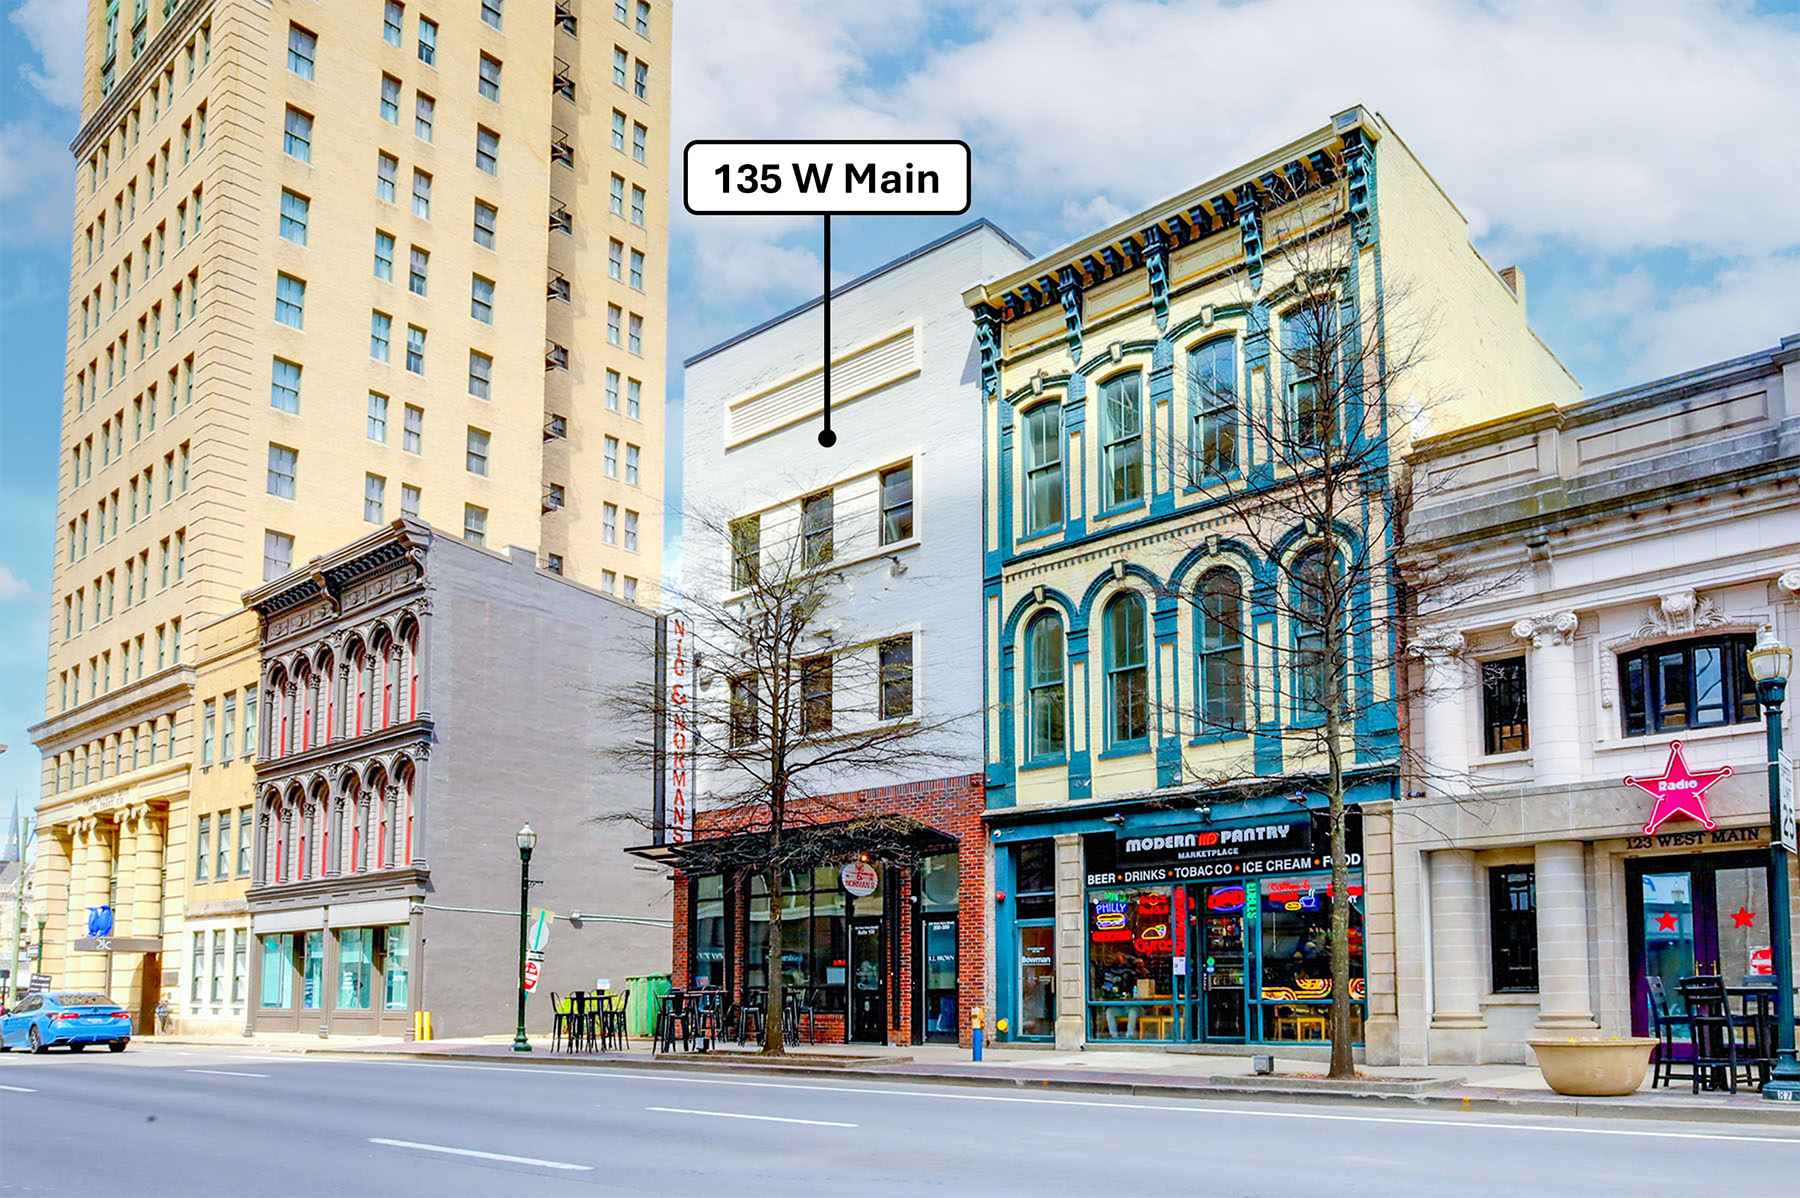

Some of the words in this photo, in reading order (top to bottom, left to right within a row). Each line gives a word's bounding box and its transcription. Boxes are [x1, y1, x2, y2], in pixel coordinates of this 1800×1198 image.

[1658, 779, 1698, 792] Radio
[1783, 803, 1795, 840] 25
[1126, 833, 1196, 852] MODERN
[1221, 825, 1290, 844] PANTRY
[1625, 837, 1652, 850] 123
[1657, 832, 1706, 848] WEST
[1712, 828, 1760, 844] MAIN
[1178, 847, 1239, 860] MARKETPLACE
[1087, 873, 1116, 885] BEER
[1124, 868, 1166, 882] DRINKS
[1242, 861, 1263, 873] ICE
[1265, 857, 1312, 871] CREAM
[1095, 902, 1128, 914] PHILLY
[1134, 938, 1175, 956] Gyros
[1021, 956, 1051, 964] Bowman
